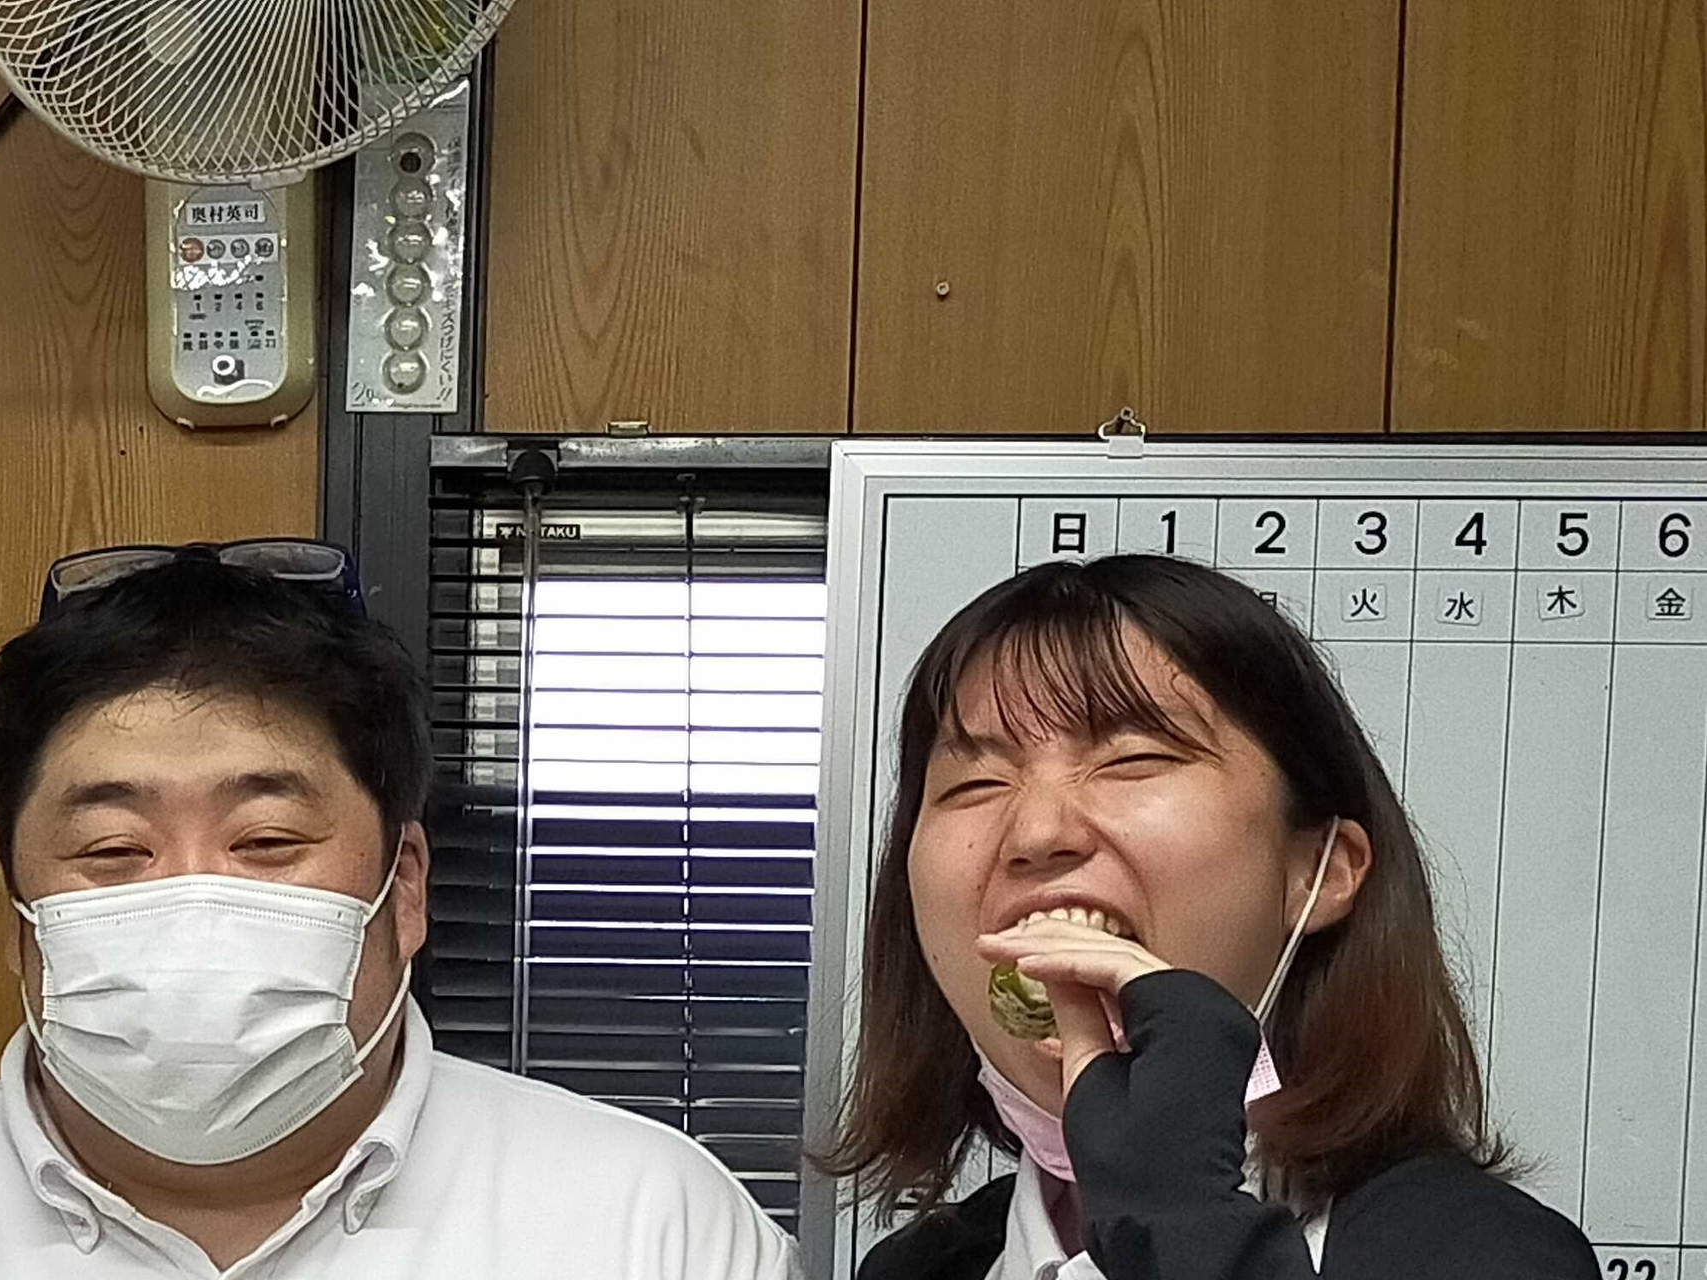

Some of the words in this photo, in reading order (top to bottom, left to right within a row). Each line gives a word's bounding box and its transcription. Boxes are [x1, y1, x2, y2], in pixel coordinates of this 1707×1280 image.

[515, 526, 577, 538] NTAKU
[1052, 513, 1087, 554] 日
[1160, 511, 1177, 554] 1
[1254, 511, 1287, 554] 2
[1355, 512, 1388, 556] 3
[1454, 512, 1488, 556] 4
[1556, 512, 1590, 556] 5
[1658, 513, 1691, 558] 6
[1351, 591, 1379, 617] 火
[1446, 591, 1475, 621] 水
[1546, 586, 1578, 615] 木
[1655, 588, 1687, 617] 金
